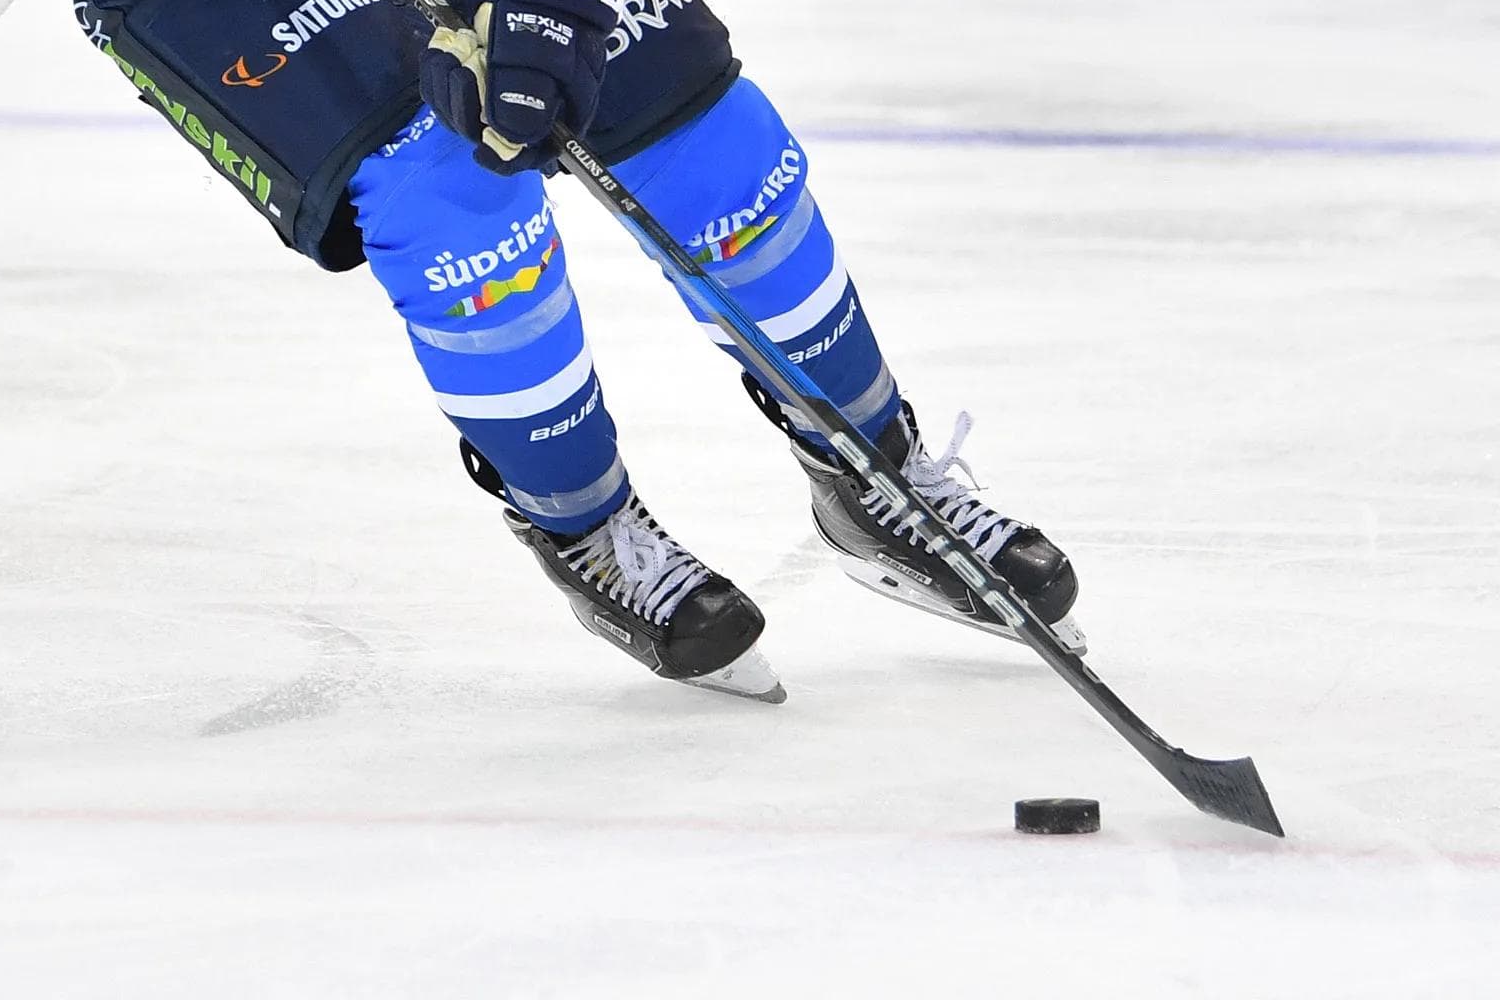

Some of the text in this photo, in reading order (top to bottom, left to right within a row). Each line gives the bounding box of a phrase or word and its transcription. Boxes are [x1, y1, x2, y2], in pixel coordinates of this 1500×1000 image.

[506, 12, 574, 39] NEXUS
[542, 28, 570, 47] PRO
[565, 139, 617, 192] COLLINS #13
